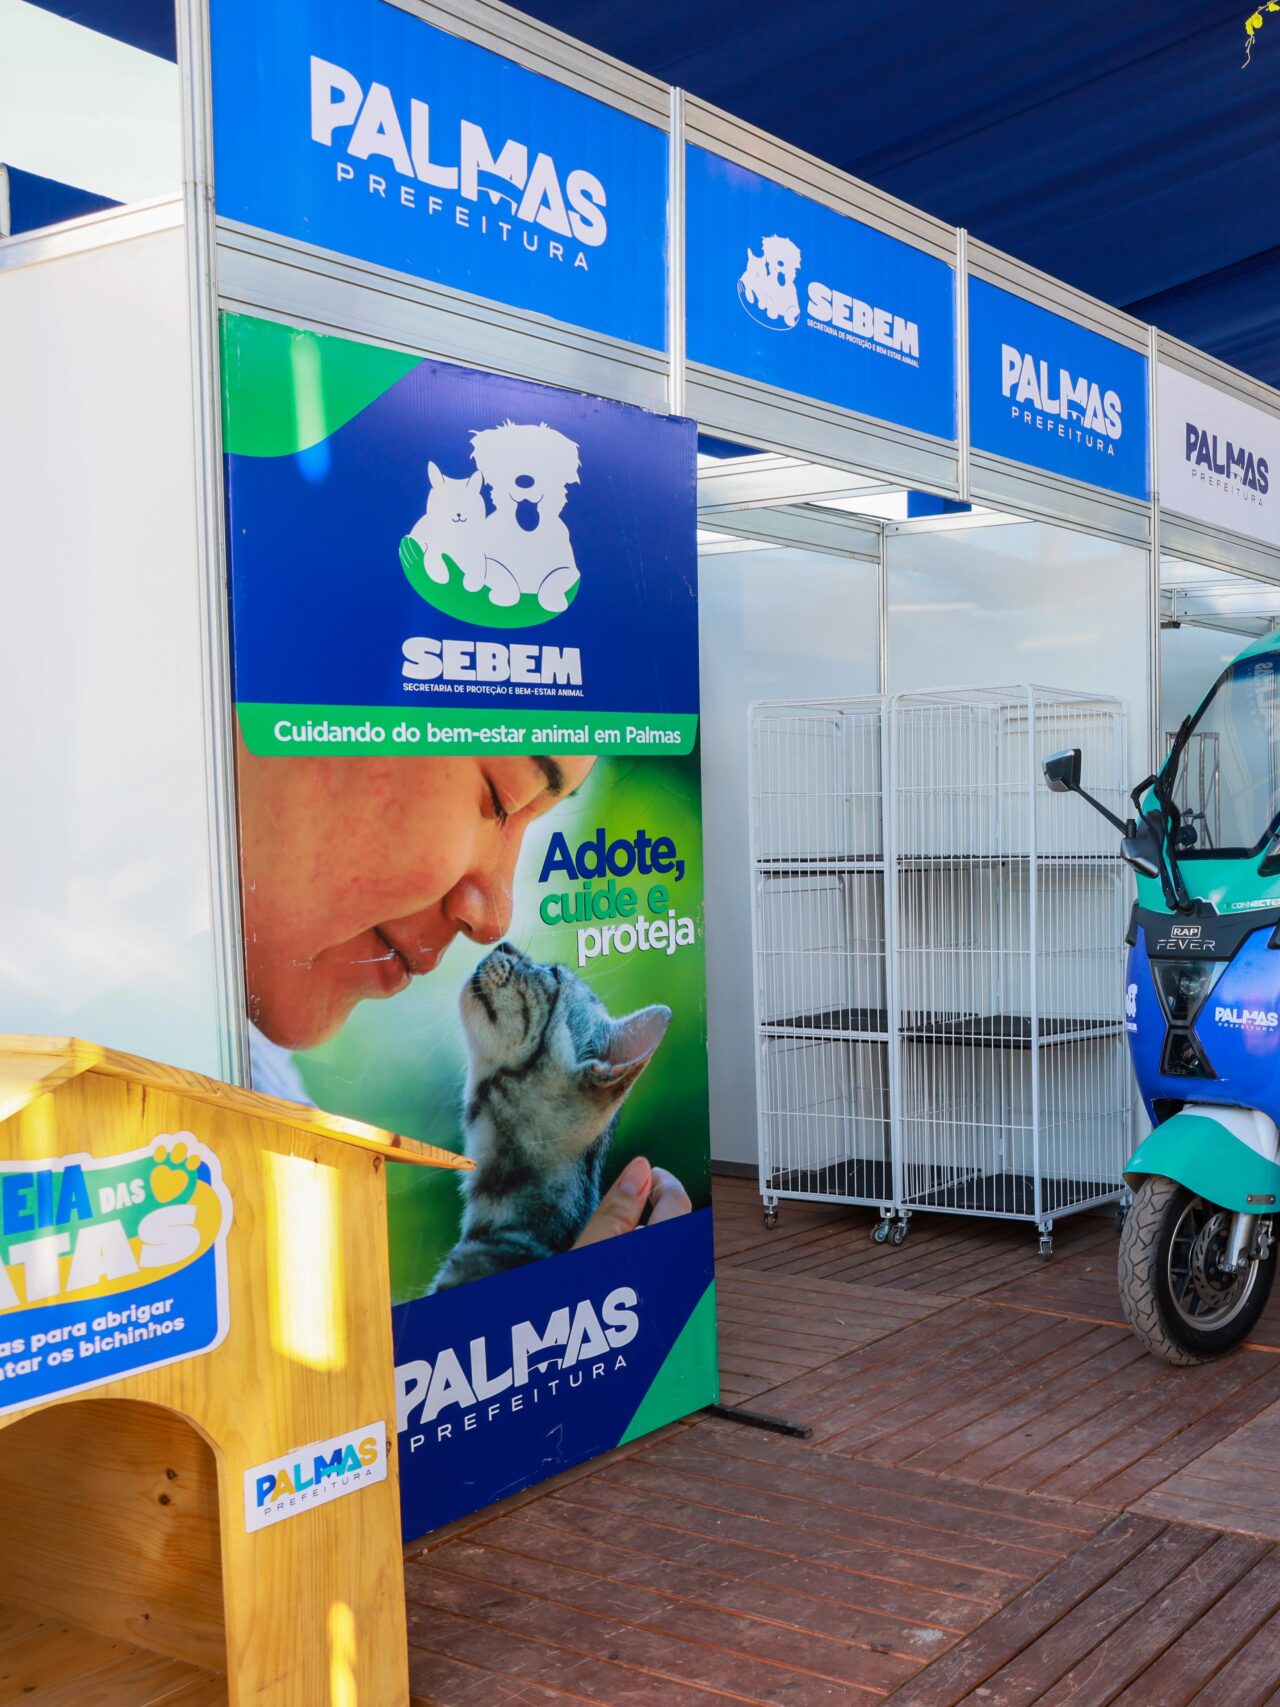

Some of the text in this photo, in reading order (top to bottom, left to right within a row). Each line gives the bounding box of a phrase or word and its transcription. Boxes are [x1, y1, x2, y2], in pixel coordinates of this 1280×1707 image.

[310, 55, 607, 247] PALMAS
[337, 161, 589, 272] PREFEITURA
[807, 281, 919, 358] SEBEM
[1002, 343, 1122, 440] PALMAS
[1011, 406, 1115, 456] PREFEITURA
[1186, 422, 1269, 495] PALMAS
[1192, 469, 1264, 507] PREFEITURA
[402, 636, 583, 686] SEBEM
[403, 682, 585, 697] SECRETARIA DE PROTEÇÃO E BEM-ESTAR ANIMAL
[273, 719, 682, 745] Cuidando do bem-estar animal em Palmas
[538, 827, 685, 883] Adote,
[539, 878, 670, 925] cuide e
[577, 909, 695, 967] proteja
[1156, 939, 1216, 952] FEVER
[1173, 928, 1198, 936] RAP
[1215, 1007, 1279, 1027] PALMAS
[98, 1178, 146, 1214] DAS
[0, 1203, 201, 1310] TAS
[0, 1317, 185, 1381] tar os bichinhos
[30, 1322, 87, 1352] para
[91, 1299, 174, 1332] abrigar
[394, 1286, 639, 1433] PALMAS
[410, 1354, 627, 1453] PREFEITURA
[256, 1437, 378, 1508] PALMAS
[264, 1468, 373, 1516] PREFEITURA
